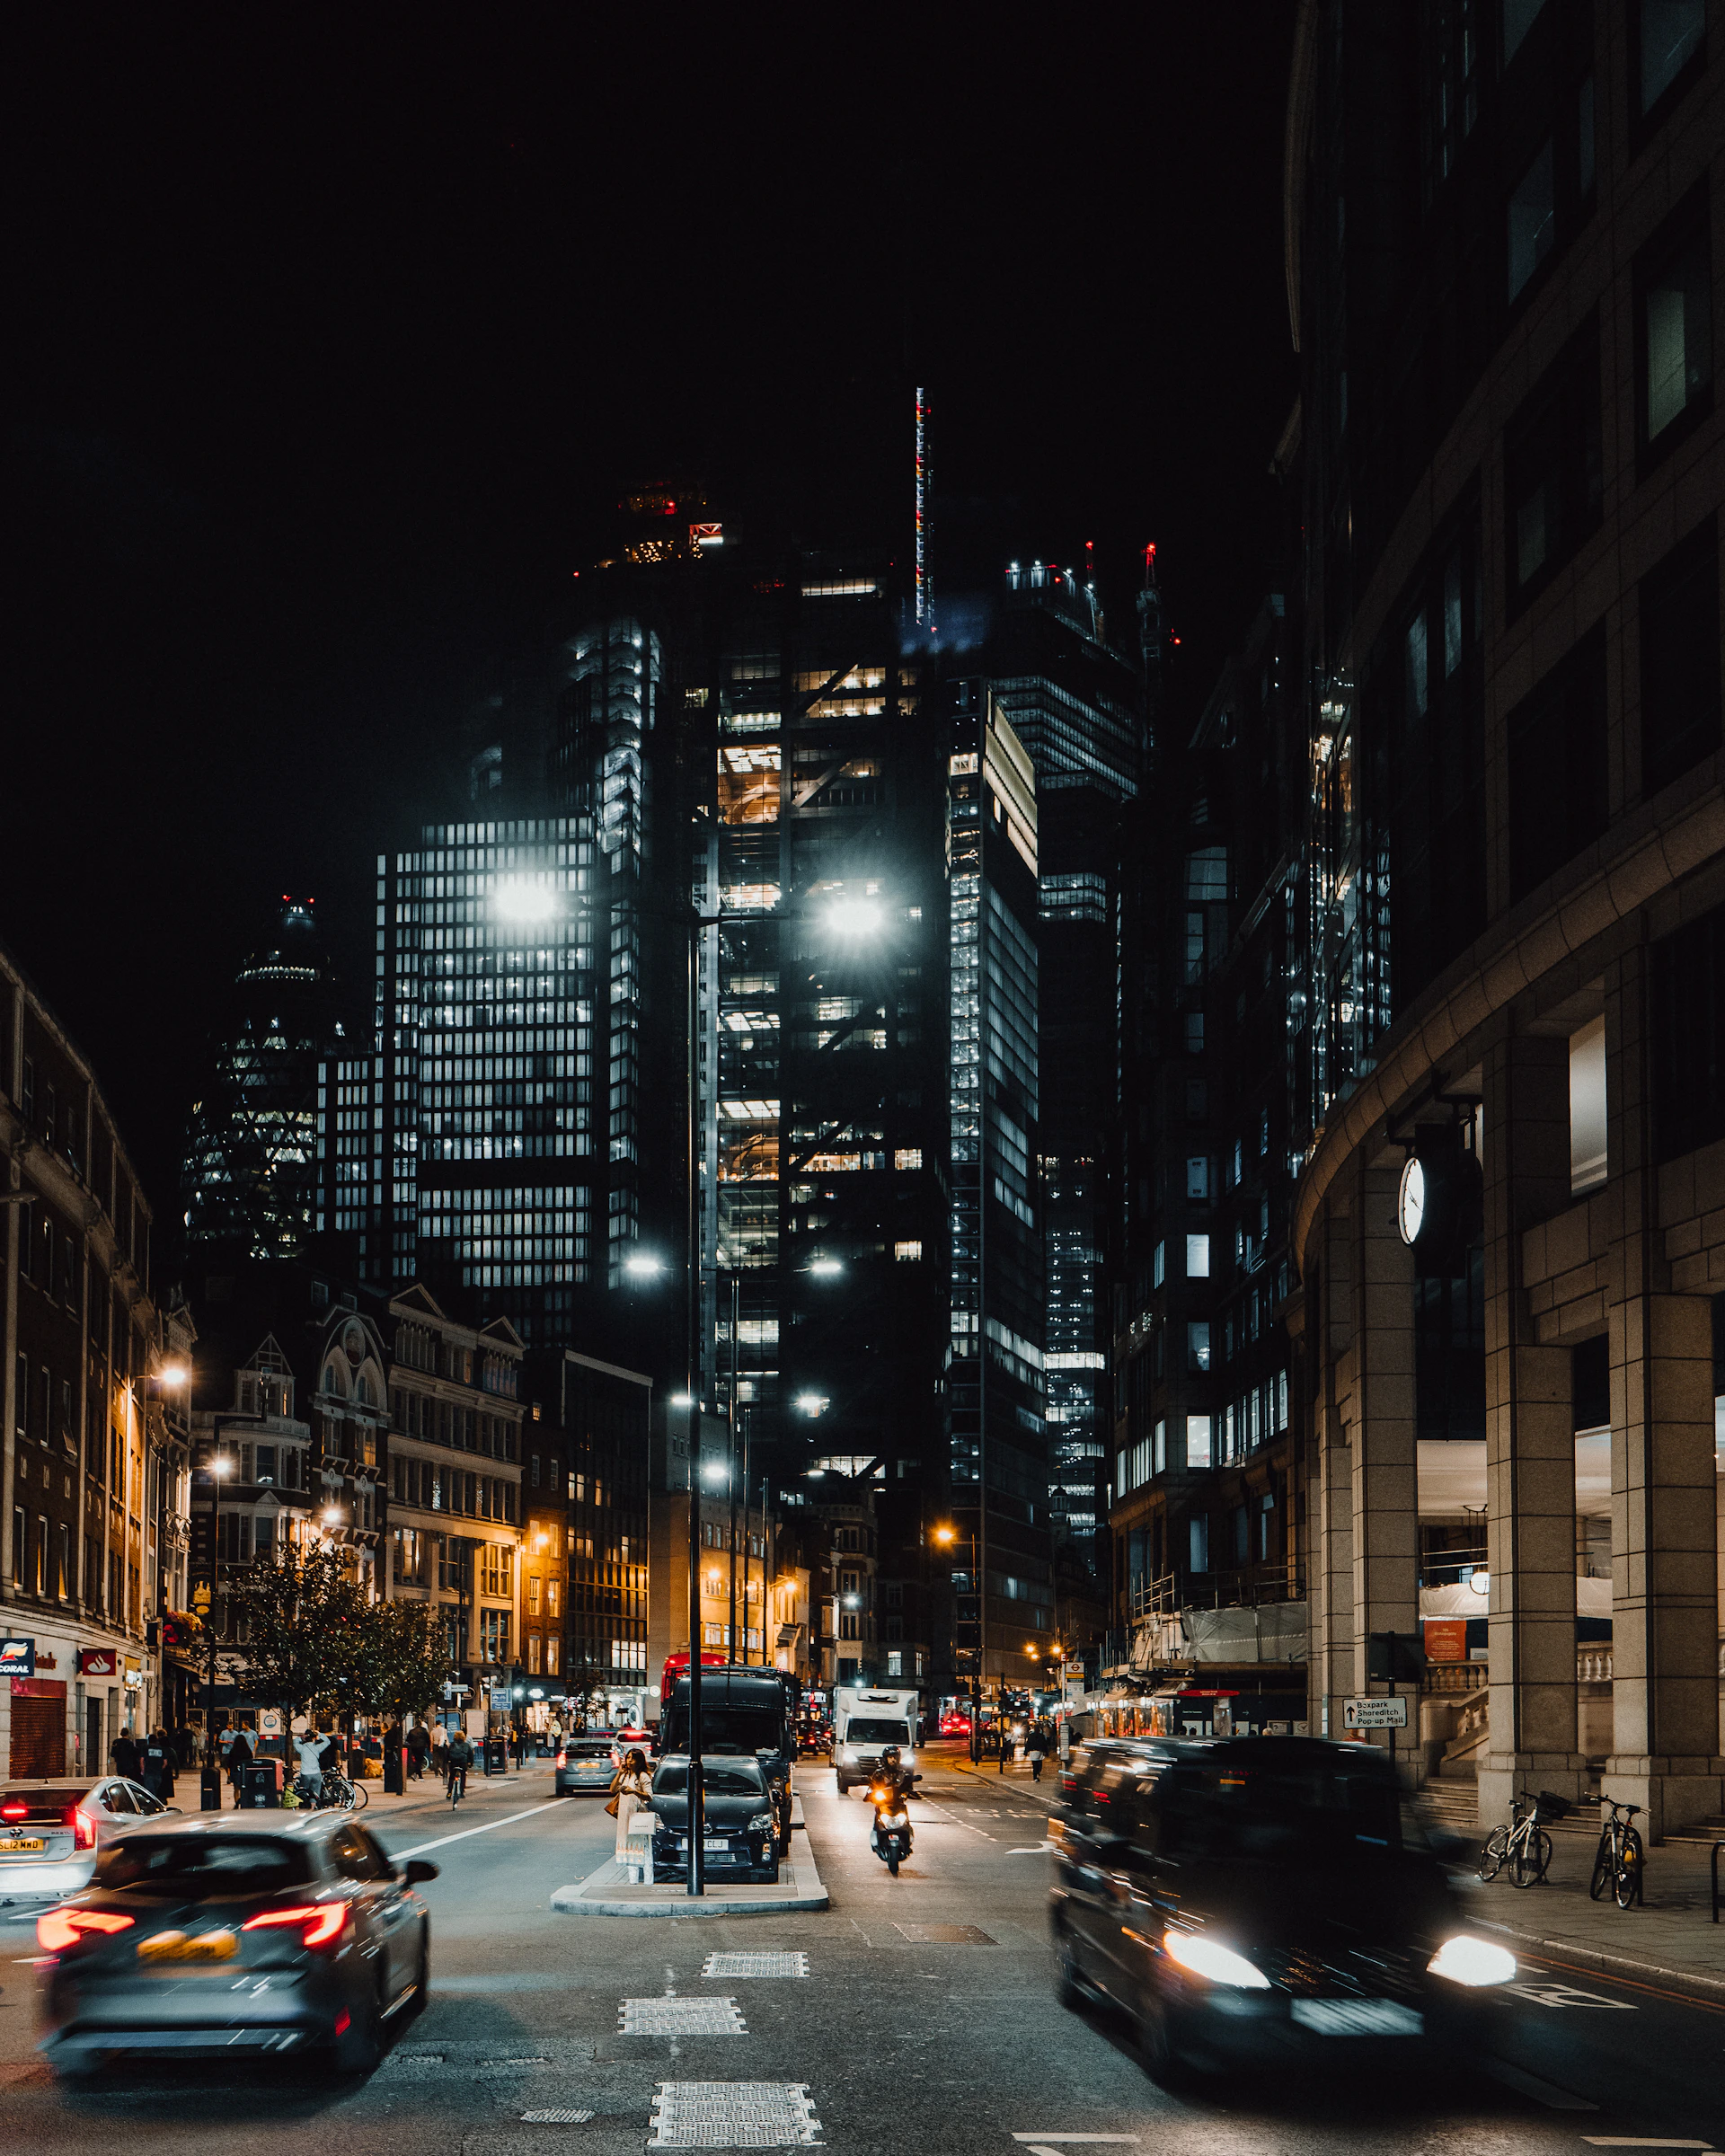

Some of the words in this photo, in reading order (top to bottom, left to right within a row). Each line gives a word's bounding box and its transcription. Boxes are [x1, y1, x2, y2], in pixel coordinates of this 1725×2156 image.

[1061, 1653, 1066, 1661] E
[0, 1665, 30, 1674] CORAL
[1358, 1709, 1399, 1717] Shoreditch
